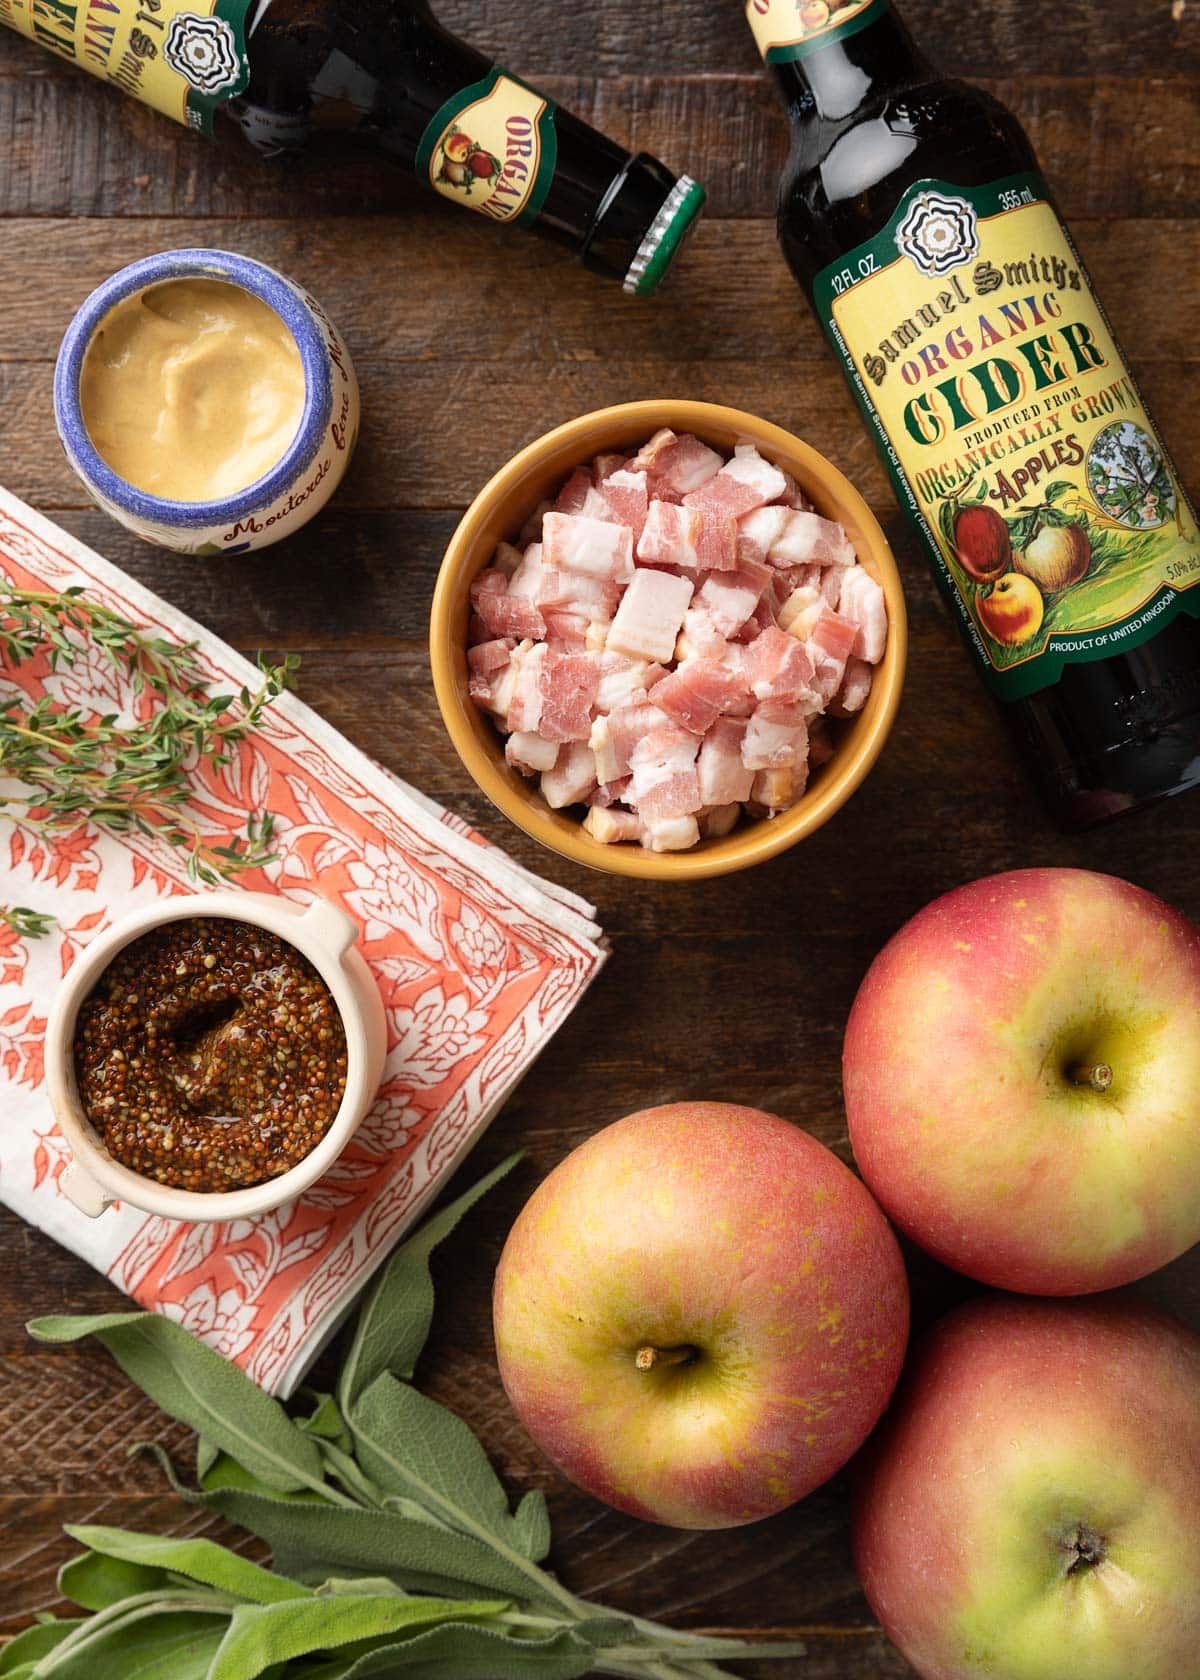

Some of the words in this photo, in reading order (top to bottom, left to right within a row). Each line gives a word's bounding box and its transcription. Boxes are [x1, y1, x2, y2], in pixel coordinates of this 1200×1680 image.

[998, 189, 1022, 211] 355
[858, 253, 882, 277] OZ.
[863, 275, 971, 386] Samuel
[971, 253, 1082, 296] Smith's
[900, 291, 1063, 386] ORGANIC
[903, 321, 1109, 447] CIDER
[223, 459, 331, 541] Moutarde
[331, 393, 350, 450] fine
[827, 317, 850, 357] Bottled
[843, 356, 857, 373] by
[851, 371, 876, 414] Samuel
[870, 413, 890, 445] Smith
[885, 445, 899, 466] Old
[893, 466, 919, 511] Brewery
[914, 412, 1065, 505] ORGANICALLY
[1071, 376, 1137, 424] GROWN
[963, 403, 1042, 450] PRODUCED
[1043, 386, 1083, 411] FROM
[1049, 638, 1094, 653] PRODUCT
[1095, 633, 1109, 647] OF
[1108, 618, 1143, 641] UNITED
[1141, 590, 1177, 624] KINGDOM
